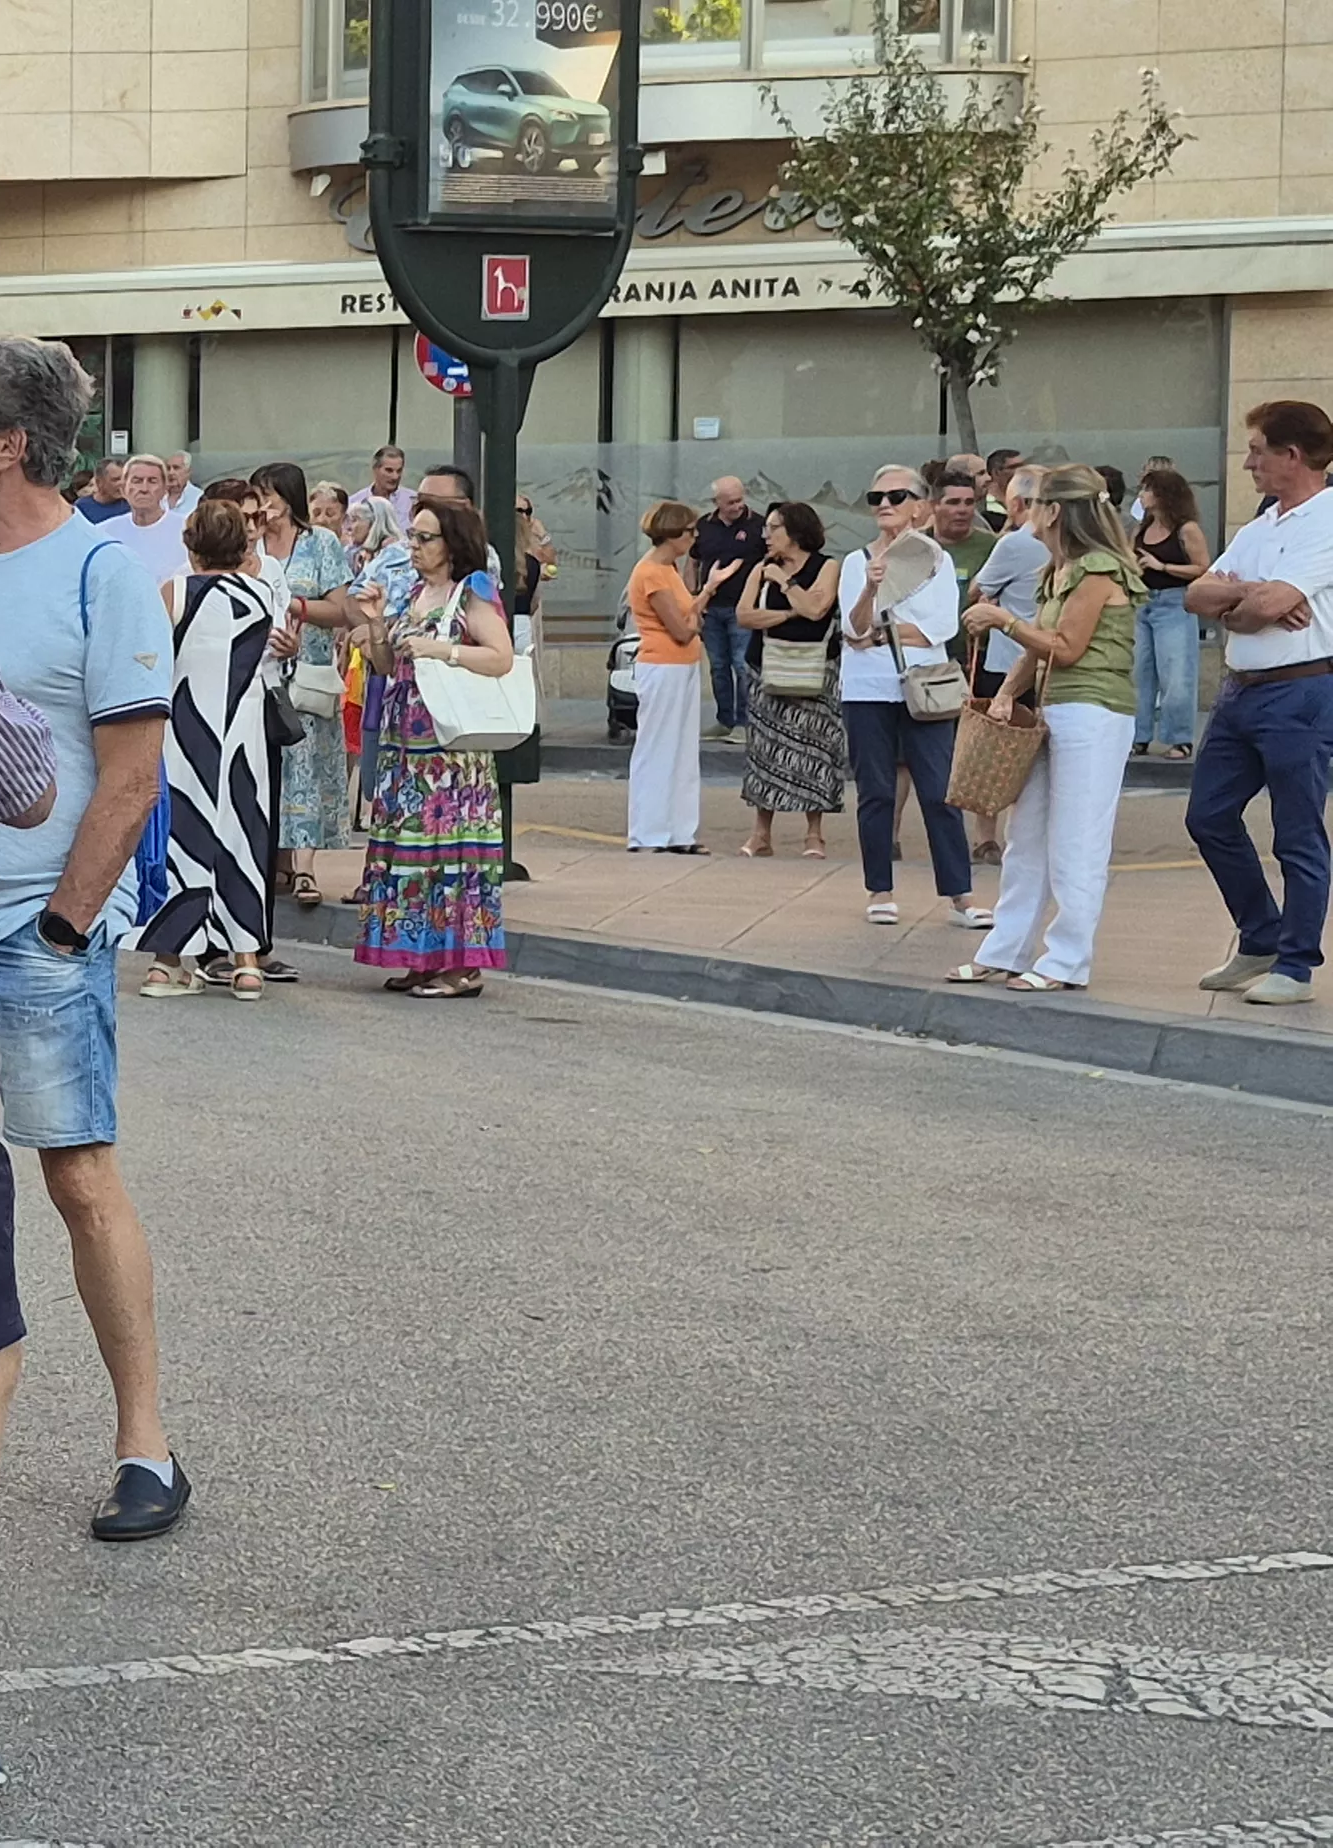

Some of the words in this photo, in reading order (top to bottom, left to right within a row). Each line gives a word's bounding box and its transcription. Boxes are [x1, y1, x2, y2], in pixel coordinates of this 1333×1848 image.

[340, 292, 400, 315] REST
[609, 278, 698, 303] RANJA
[708, 275, 800, 300] ANITA
